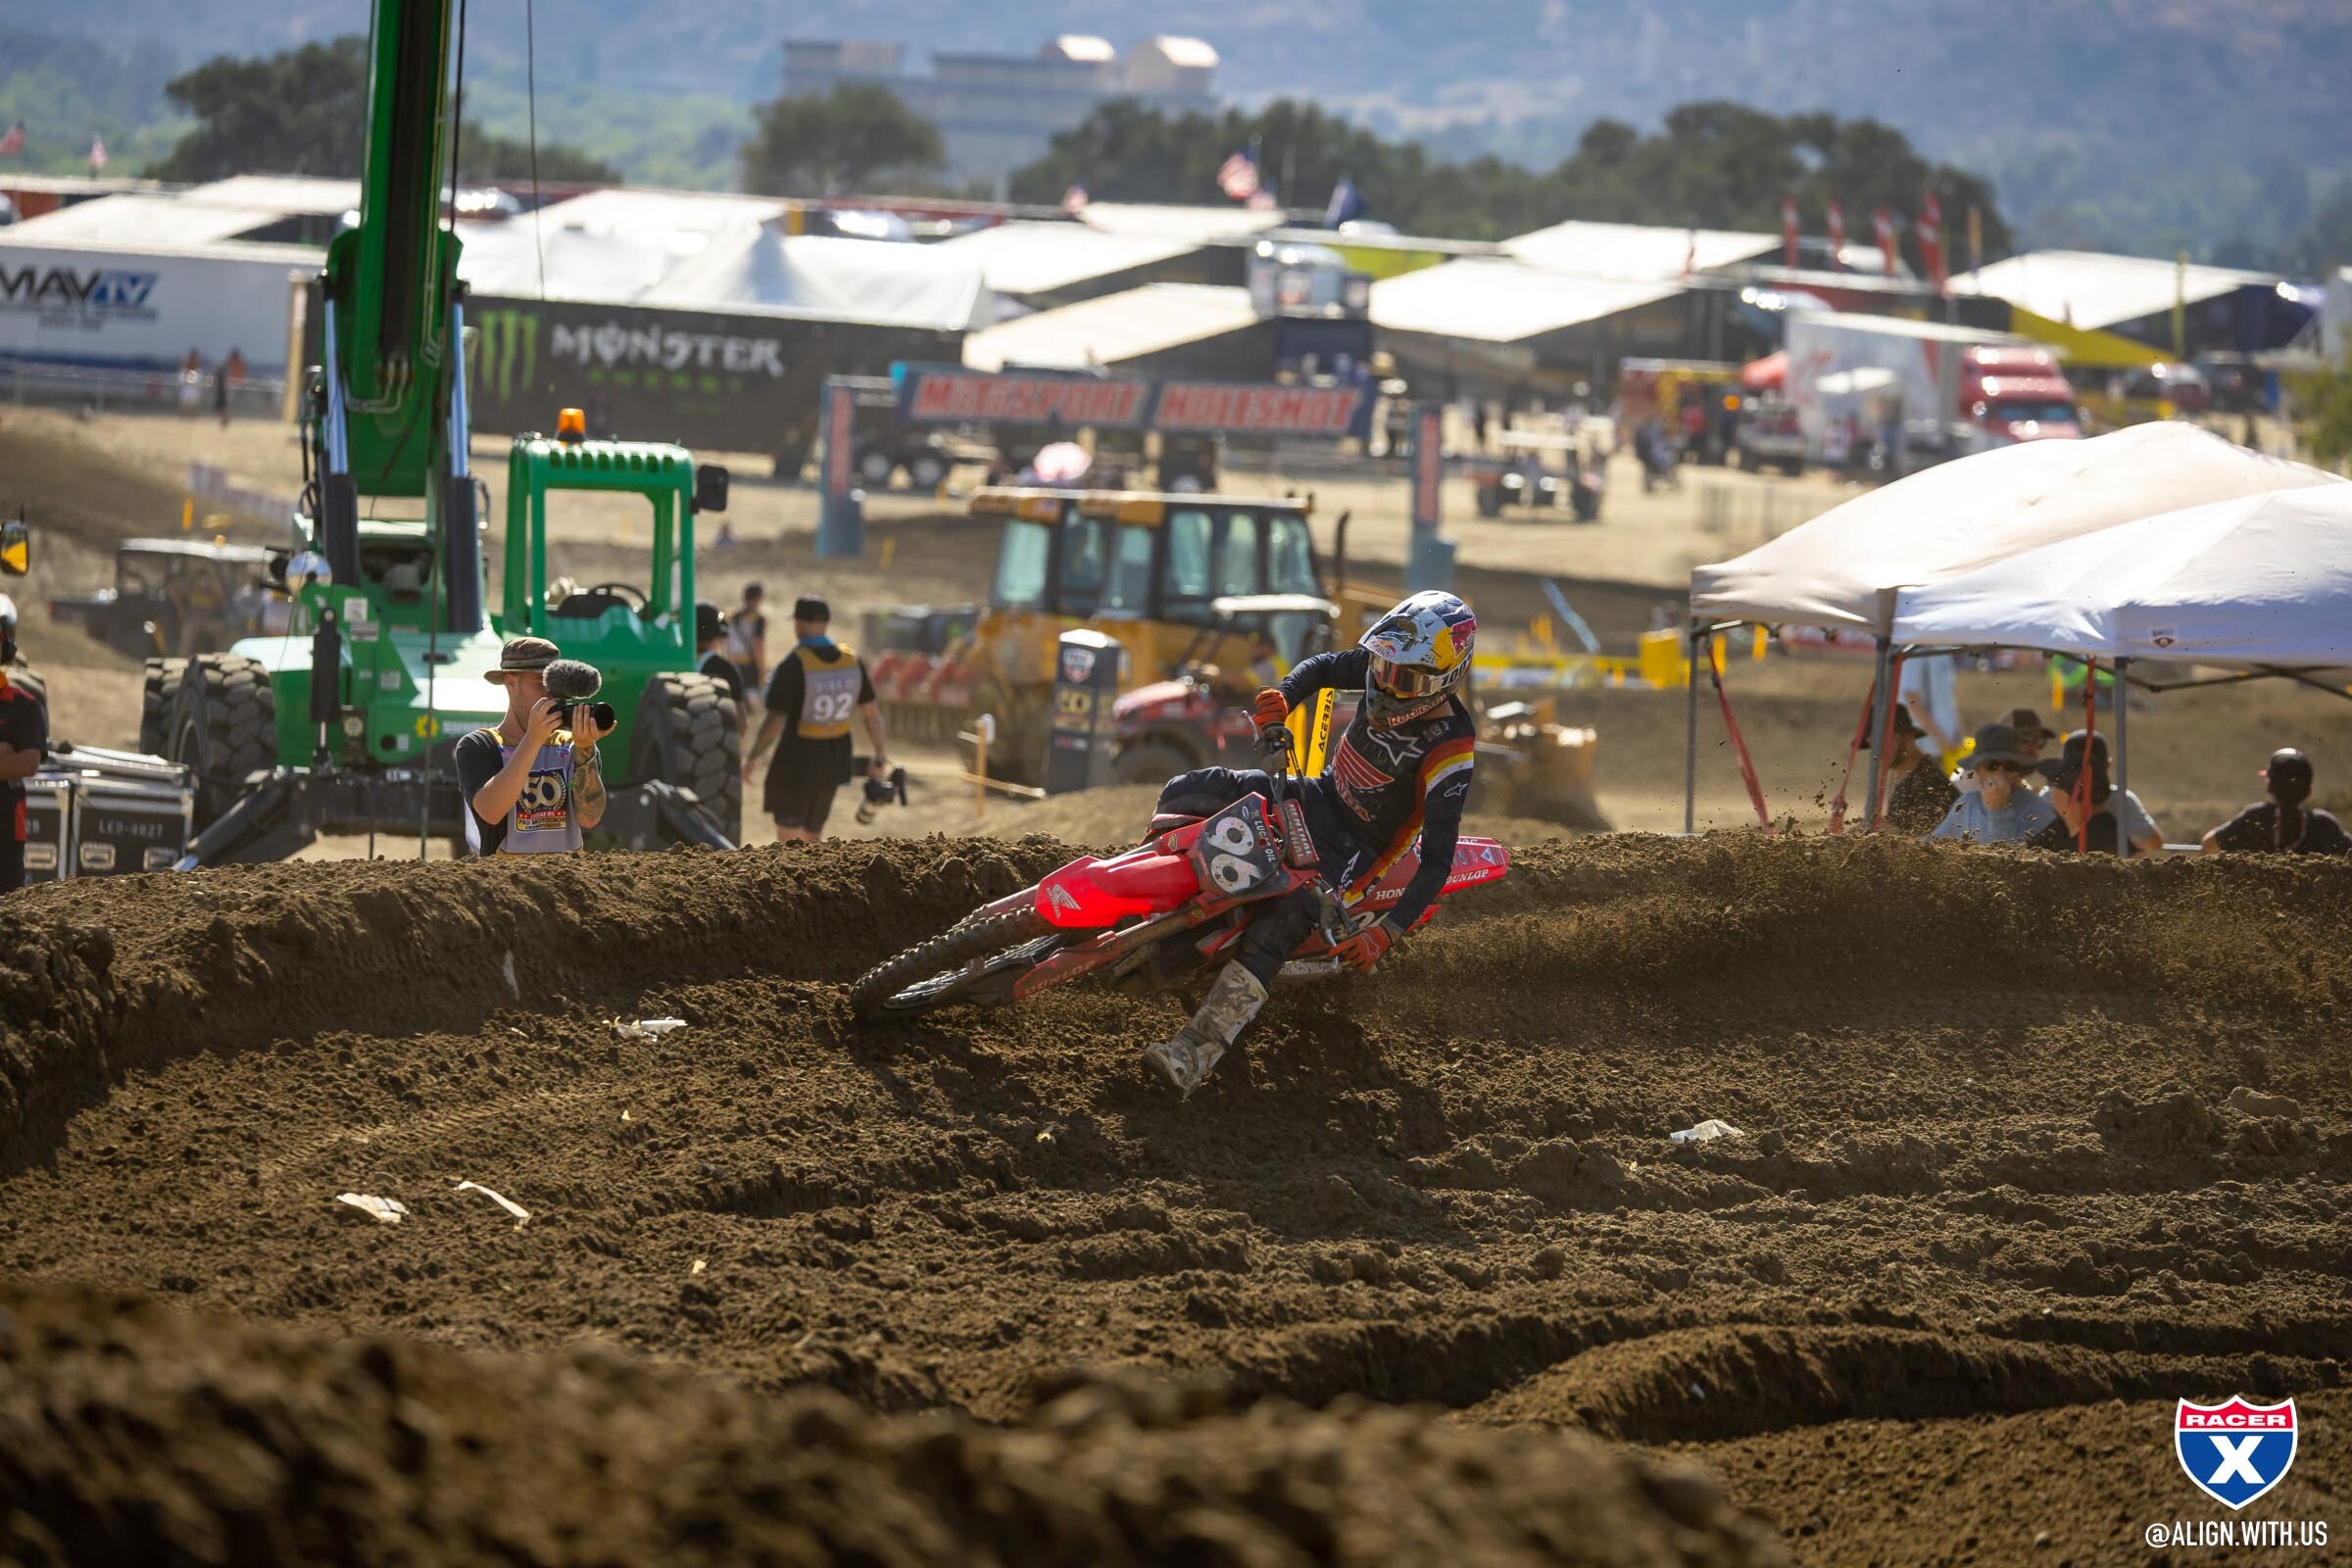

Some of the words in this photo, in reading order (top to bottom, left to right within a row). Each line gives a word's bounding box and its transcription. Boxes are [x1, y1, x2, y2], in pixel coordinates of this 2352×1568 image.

[551, 318, 786, 377] MONSTER
[813, 692, 853, 722] 92
[1318, 690, 1333, 754] ACERBIS
[523, 774, 563, 809] 50
[1289, 804, 1312, 858] RENTHAL
[1264, 848, 1276, 862] OIL
[1446, 868, 1490, 885] DUNLOP
[1375, 888, 1406, 901] HON
